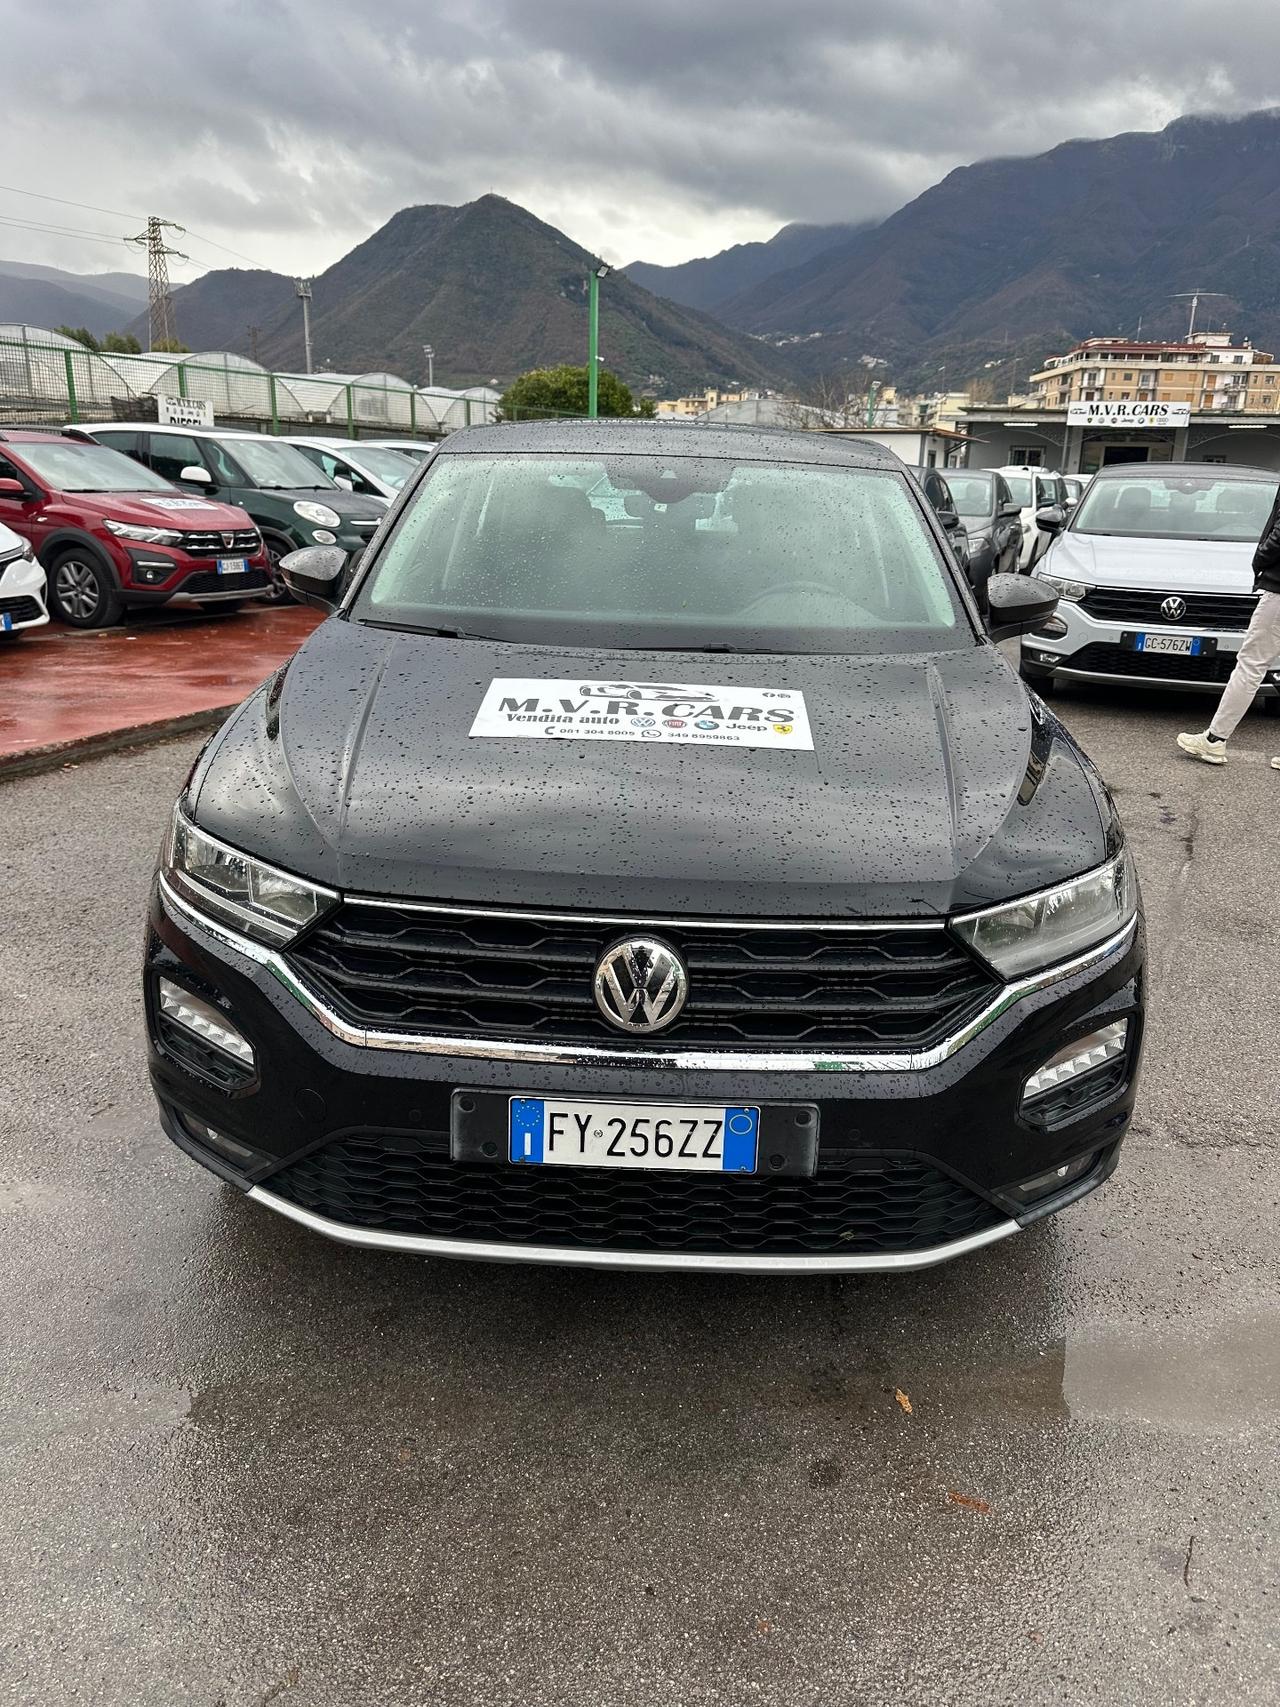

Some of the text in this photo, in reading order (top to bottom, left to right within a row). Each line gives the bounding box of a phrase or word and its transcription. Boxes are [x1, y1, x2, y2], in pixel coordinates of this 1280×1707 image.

[506, 713, 620, 725] Vendita auto
[726, 723, 768, 732] Jeep
[547, 1112, 593, 1153] FY
[605, 1117, 723, 1159] 256ZZ
